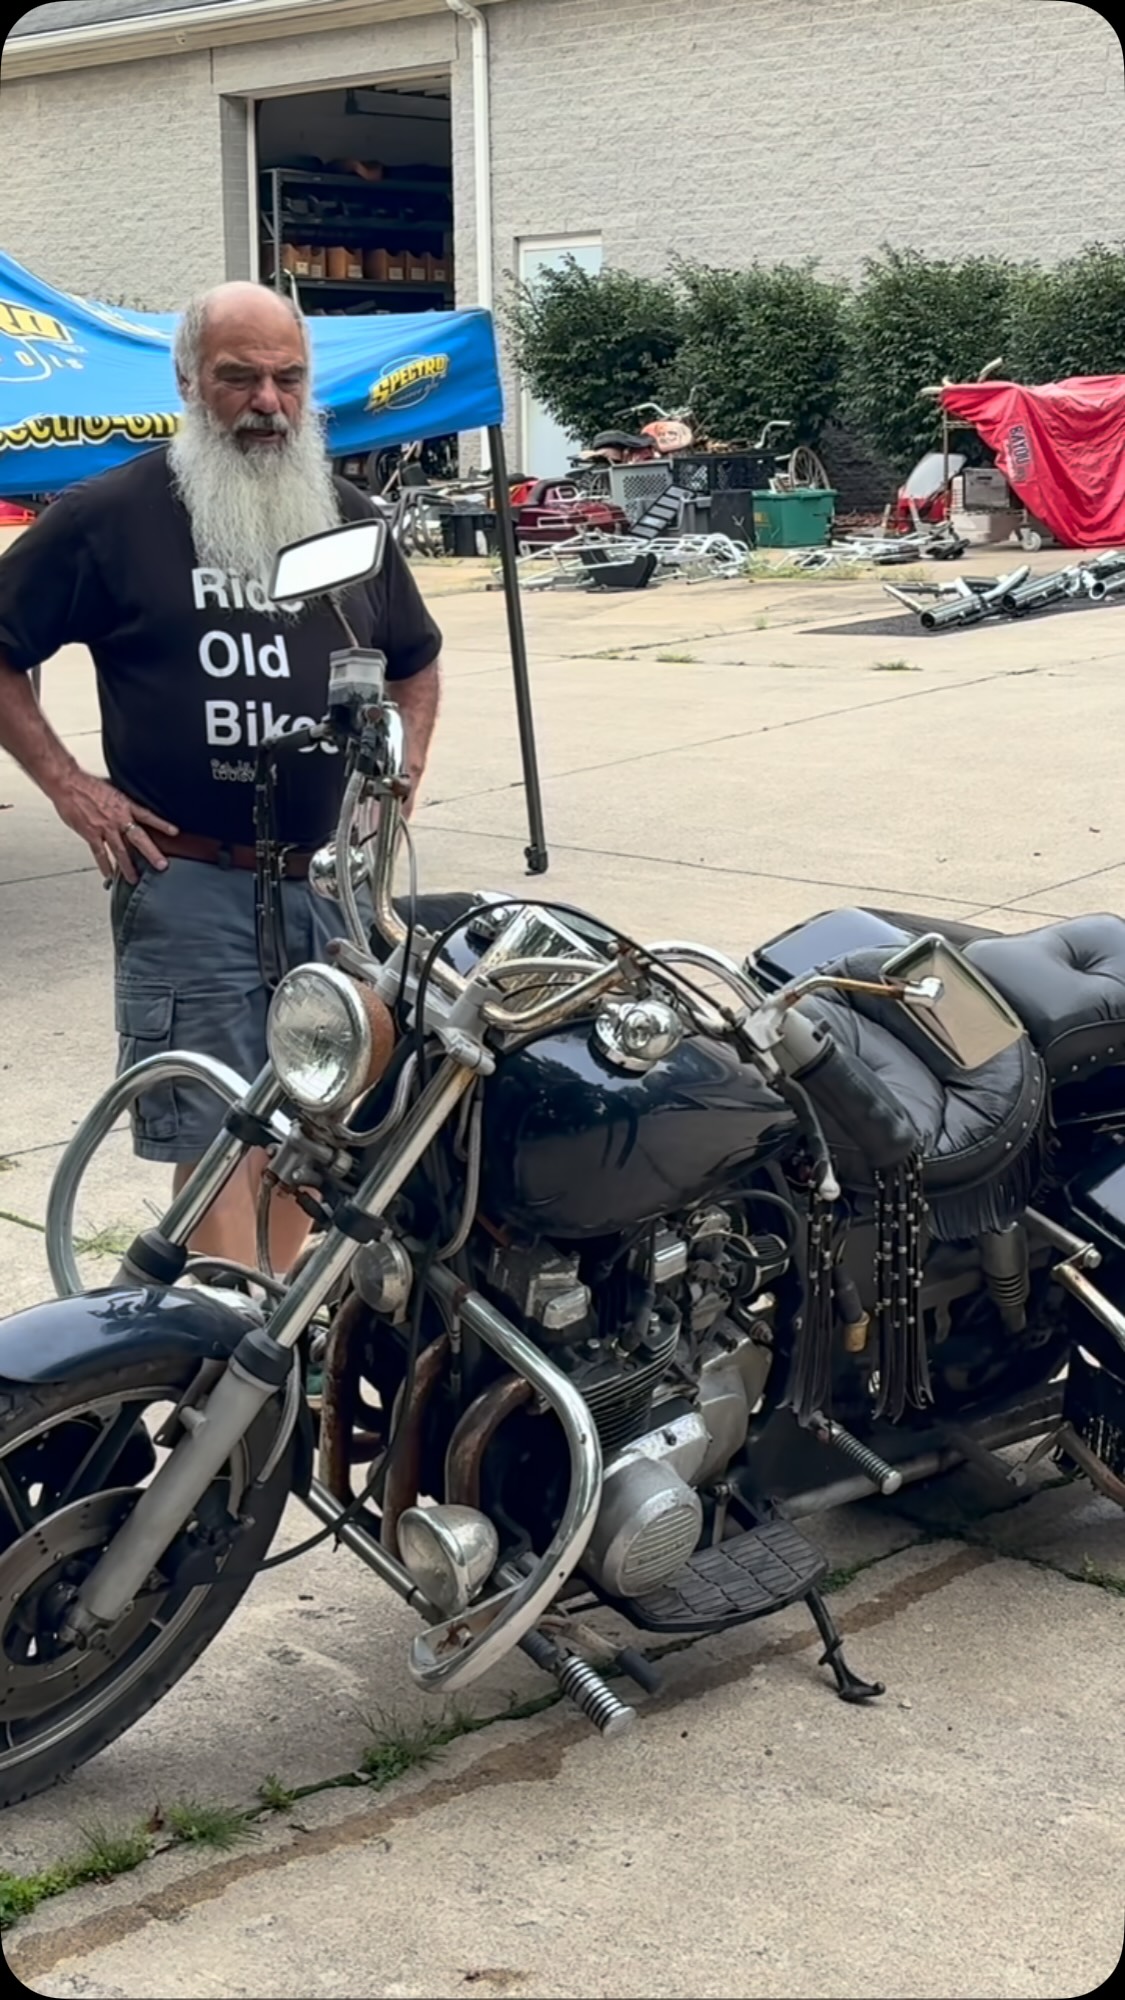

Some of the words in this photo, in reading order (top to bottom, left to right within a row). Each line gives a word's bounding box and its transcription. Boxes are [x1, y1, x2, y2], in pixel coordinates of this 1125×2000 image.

[368, 355, 447, 409] SPECTRO
[192, 567, 304, 613] Rid
[199, 631, 291, 679] Old
[205, 700, 339, 754] Bike
